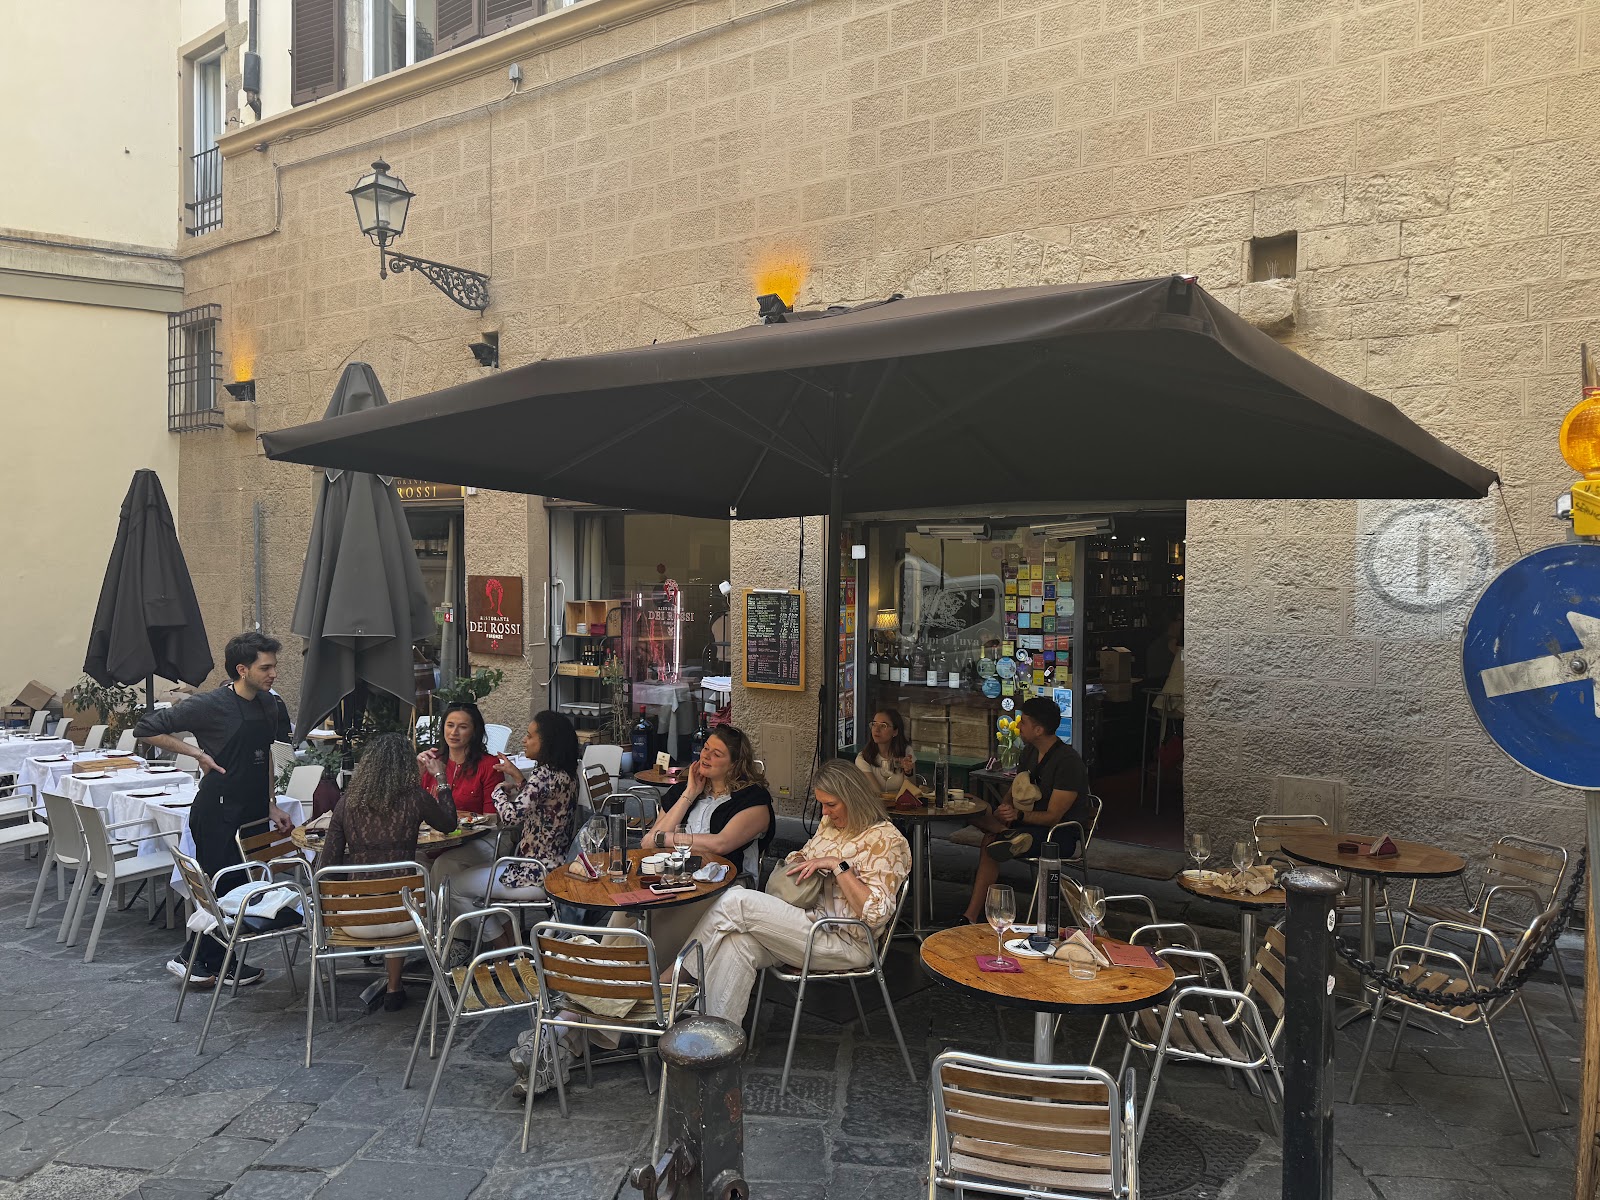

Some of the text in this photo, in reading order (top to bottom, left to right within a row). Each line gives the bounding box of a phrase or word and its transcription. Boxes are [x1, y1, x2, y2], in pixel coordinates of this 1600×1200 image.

[397, 486, 437, 499] ROSSI
[648, 610, 665, 621] DEI
[469, 621, 521, 635] DEI ROSSI
[1296, 791, 1322, 803] GAS
[1049, 873, 1059, 881] 75
